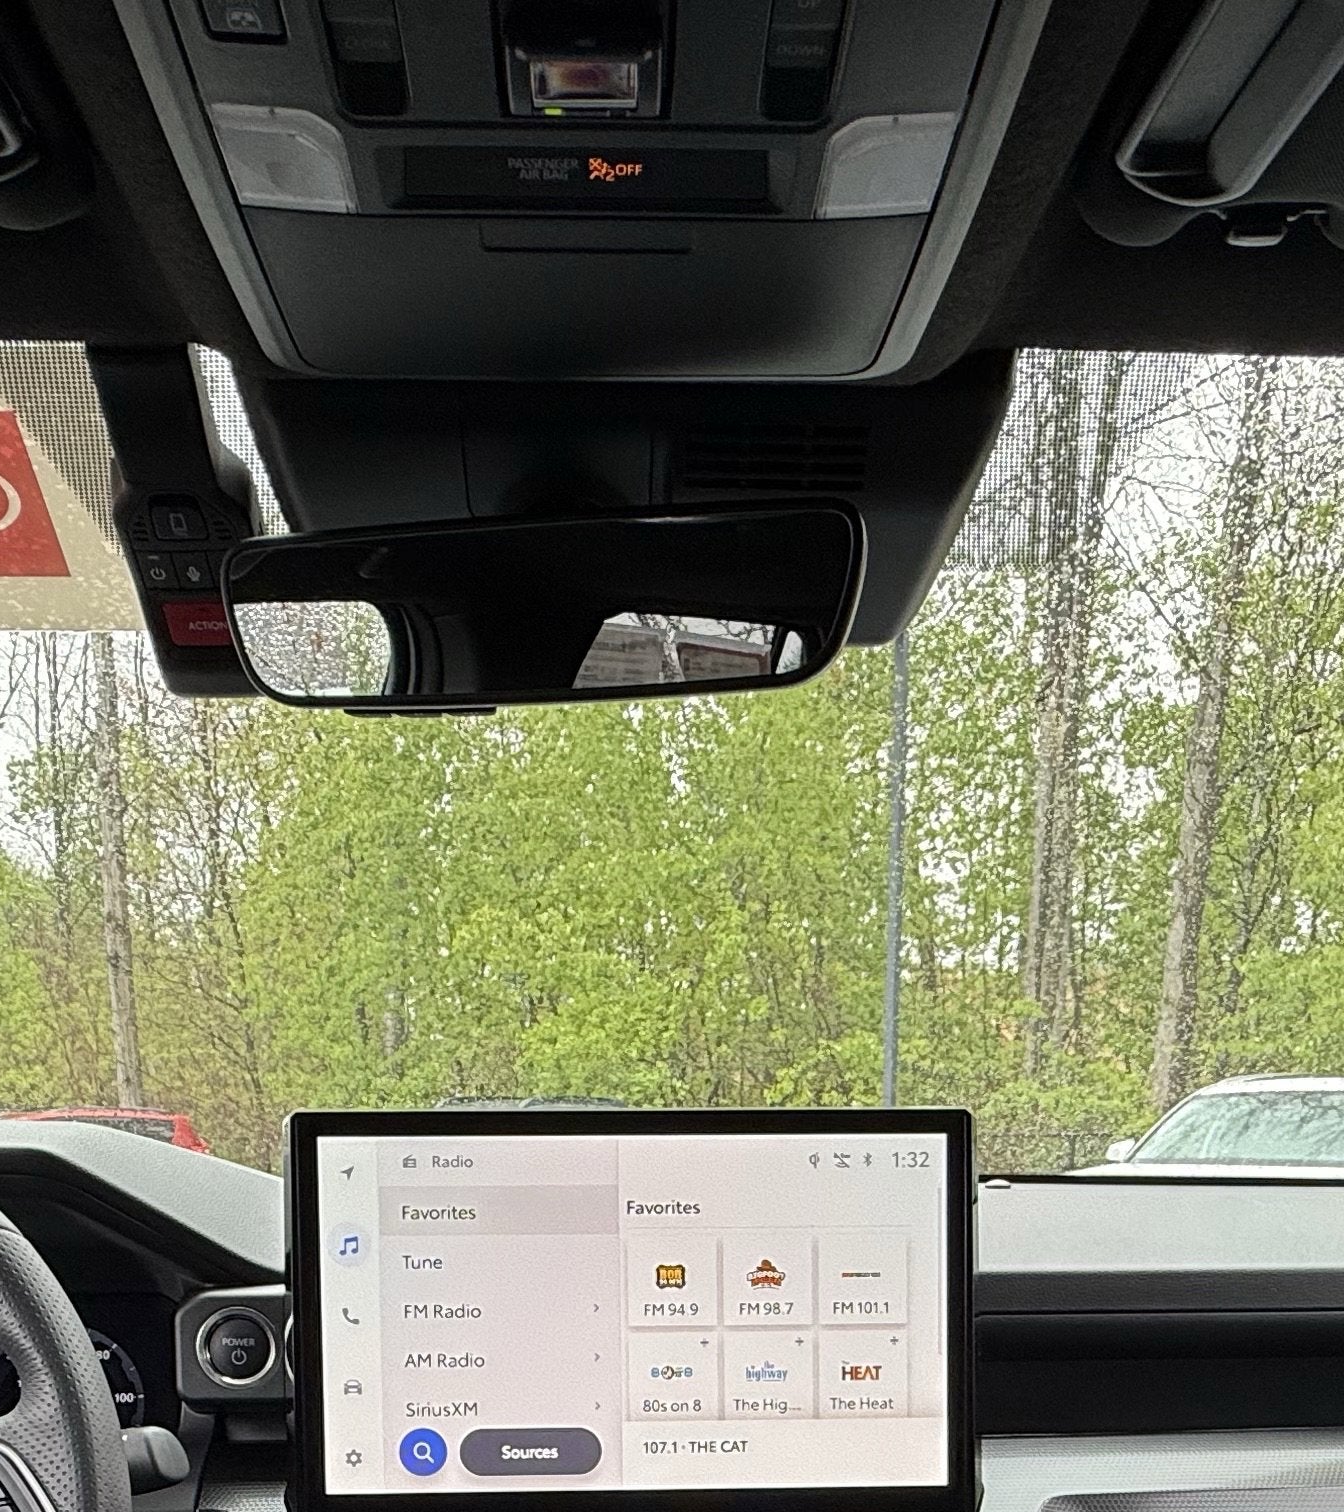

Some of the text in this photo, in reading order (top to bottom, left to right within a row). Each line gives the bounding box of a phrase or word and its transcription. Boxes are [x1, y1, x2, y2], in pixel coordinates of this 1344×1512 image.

[507, 157, 578, 169] PASSENGER
[615, 163, 643, 177] OFF
[519, 168, 568, 180] AIR BAG
[188, 620, 228, 631] ACTION
[431, 1154, 474, 1169] Radio
[891, 1150, 931, 1169] 1:32
[400, 1205, 477, 1221] Favorites
[626, 1200, 701, 1216] Favorites
[402, 1255, 443, 1270] Tune
[403, 1303, 482, 1320] FM Radio
[644, 1303, 665, 1316] FM
[739, 1301, 794, 1316] FM 98.7
[833, 1301, 890, 1315] FM 101.1
[222, 1338, 256, 1348] POWER
[404, 1354, 486, 1370] AM Radio
[745, 1364, 788, 1381] highway
[841, 1365, 883, 1381] HEAT
[114, 1393, 134, 1404] 100
[643, 1399, 702, 1413] 80s on 8
[733, 1398, 757, 1412] The
[829, 1397, 895, 1412] The Heat
[405, 1401, 480, 1418] SiriusXM
[501, 1444, 559, 1461] Sources
[642, 1439, 749, 1455] 107.1 THE CAT
